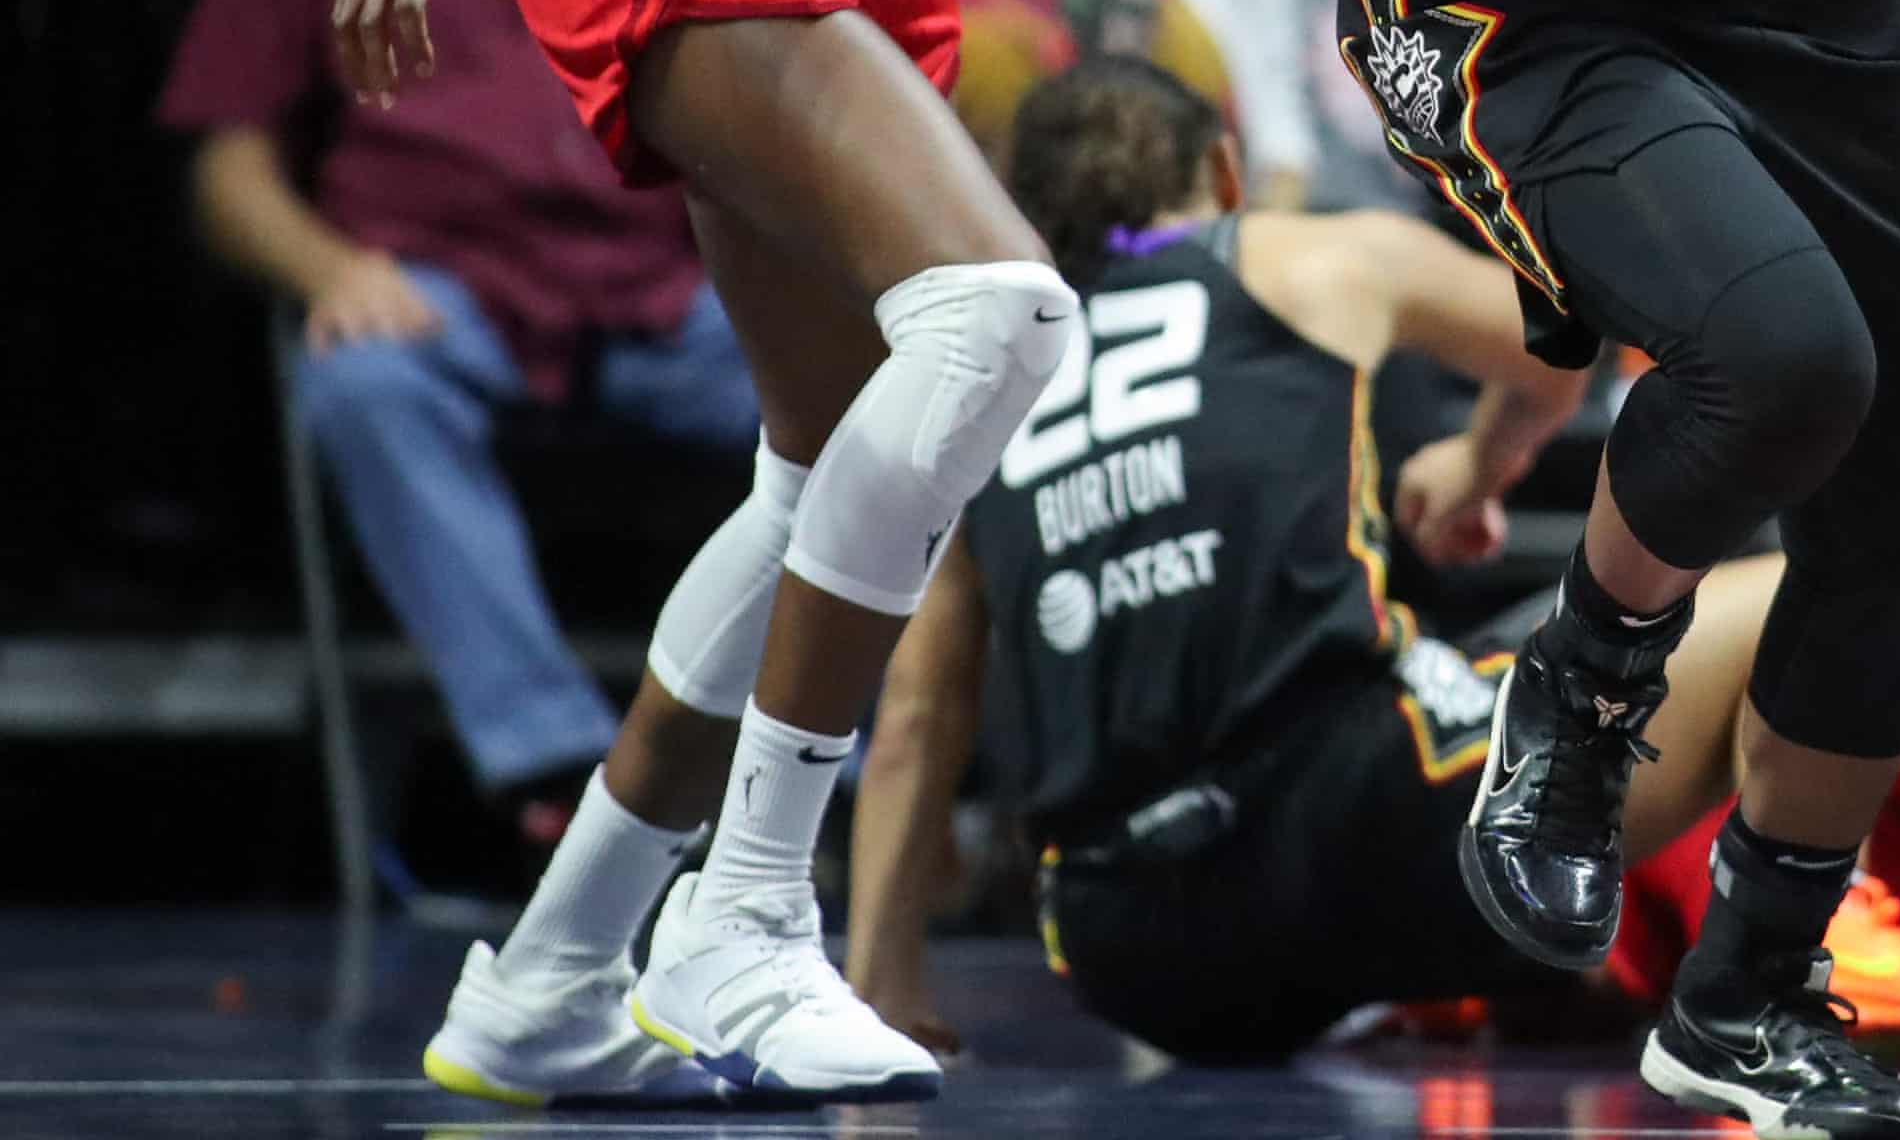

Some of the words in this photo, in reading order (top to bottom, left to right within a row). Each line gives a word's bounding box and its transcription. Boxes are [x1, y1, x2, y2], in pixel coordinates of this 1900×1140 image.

[1000, 279, 1211, 490] 22
[1034, 434, 1187, 556] BURTON
[1100, 529, 1224, 617] AT&T
